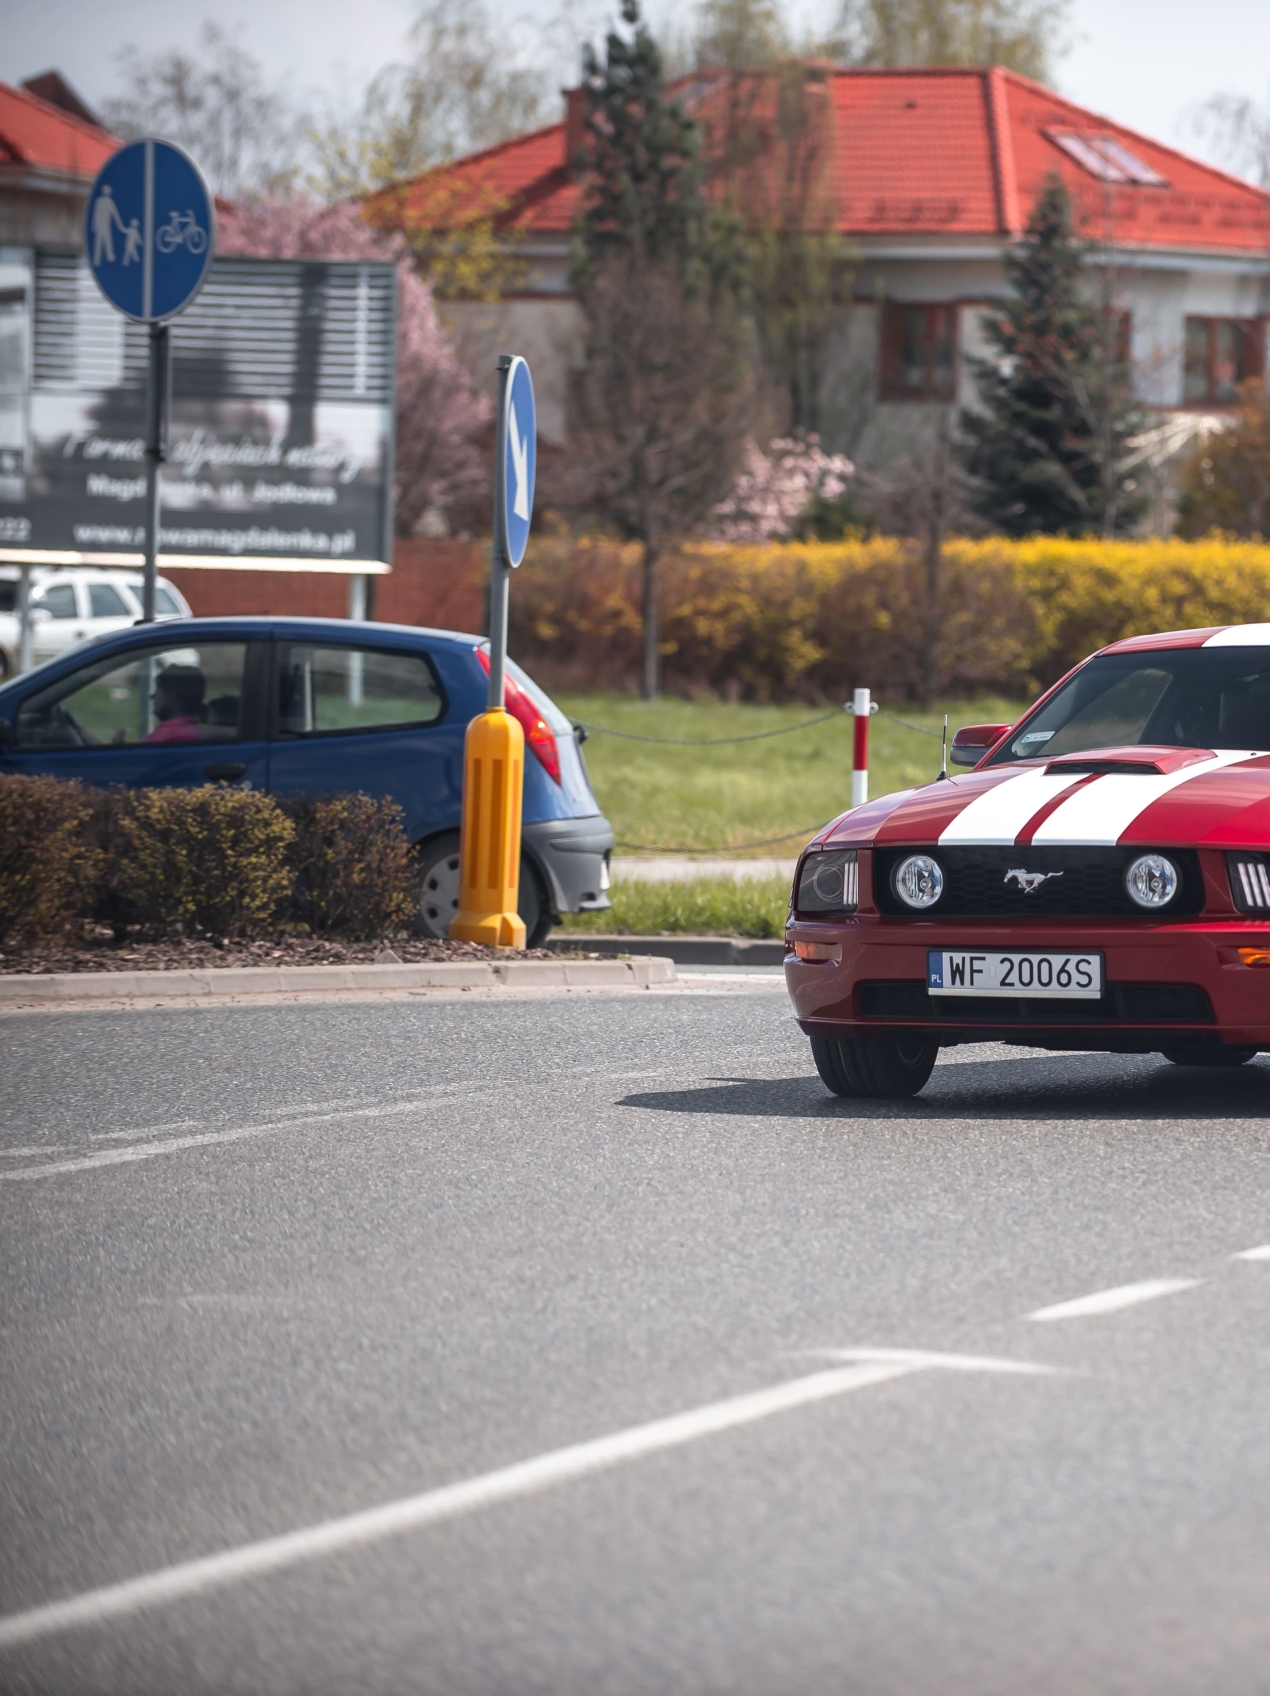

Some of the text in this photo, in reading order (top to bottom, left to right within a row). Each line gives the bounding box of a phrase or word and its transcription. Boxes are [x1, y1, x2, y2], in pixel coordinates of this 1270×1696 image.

[931, 974, 942, 983] PL
[949, 955, 1093, 989] WF 2006S
